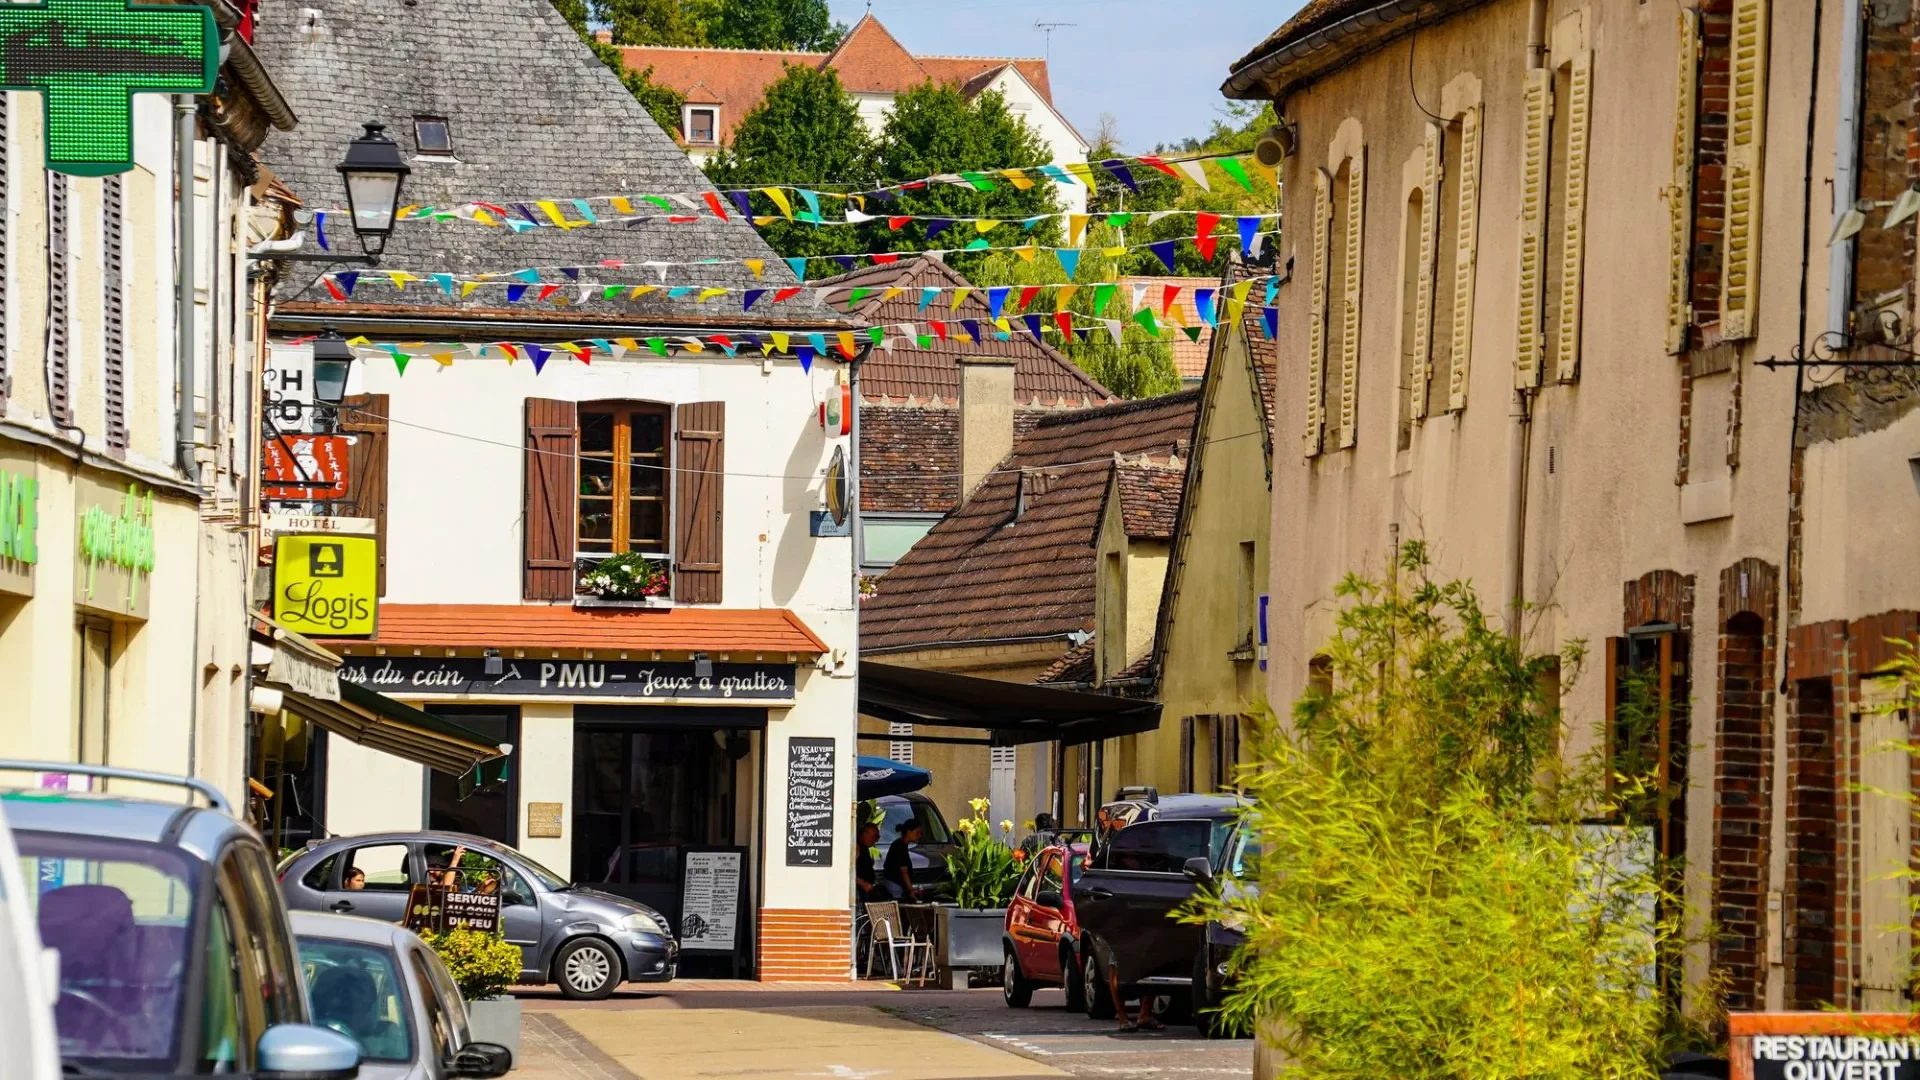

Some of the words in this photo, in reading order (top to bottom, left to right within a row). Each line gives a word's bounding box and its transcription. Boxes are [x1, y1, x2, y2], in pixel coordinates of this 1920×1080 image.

[324, 442, 344, 491] BLANC
[288, 518, 340, 530] HOTEL
[280, 579, 369, 630] Logis
[336, 664, 368, 685] ars
[372, 660, 404, 685] du
[412, 664, 464, 686] coin
[540, 663, 605, 688] PMU
[638, 668, 692, 696] Jeux
[719, 670, 788, 698] gratter
[796, 829, 832, 837] TERRASSE
[446, 893, 498, 906] SERVICE
[469, 918, 493, 929] FEU
[1784, 1060, 1901, 1080] OUVERT
